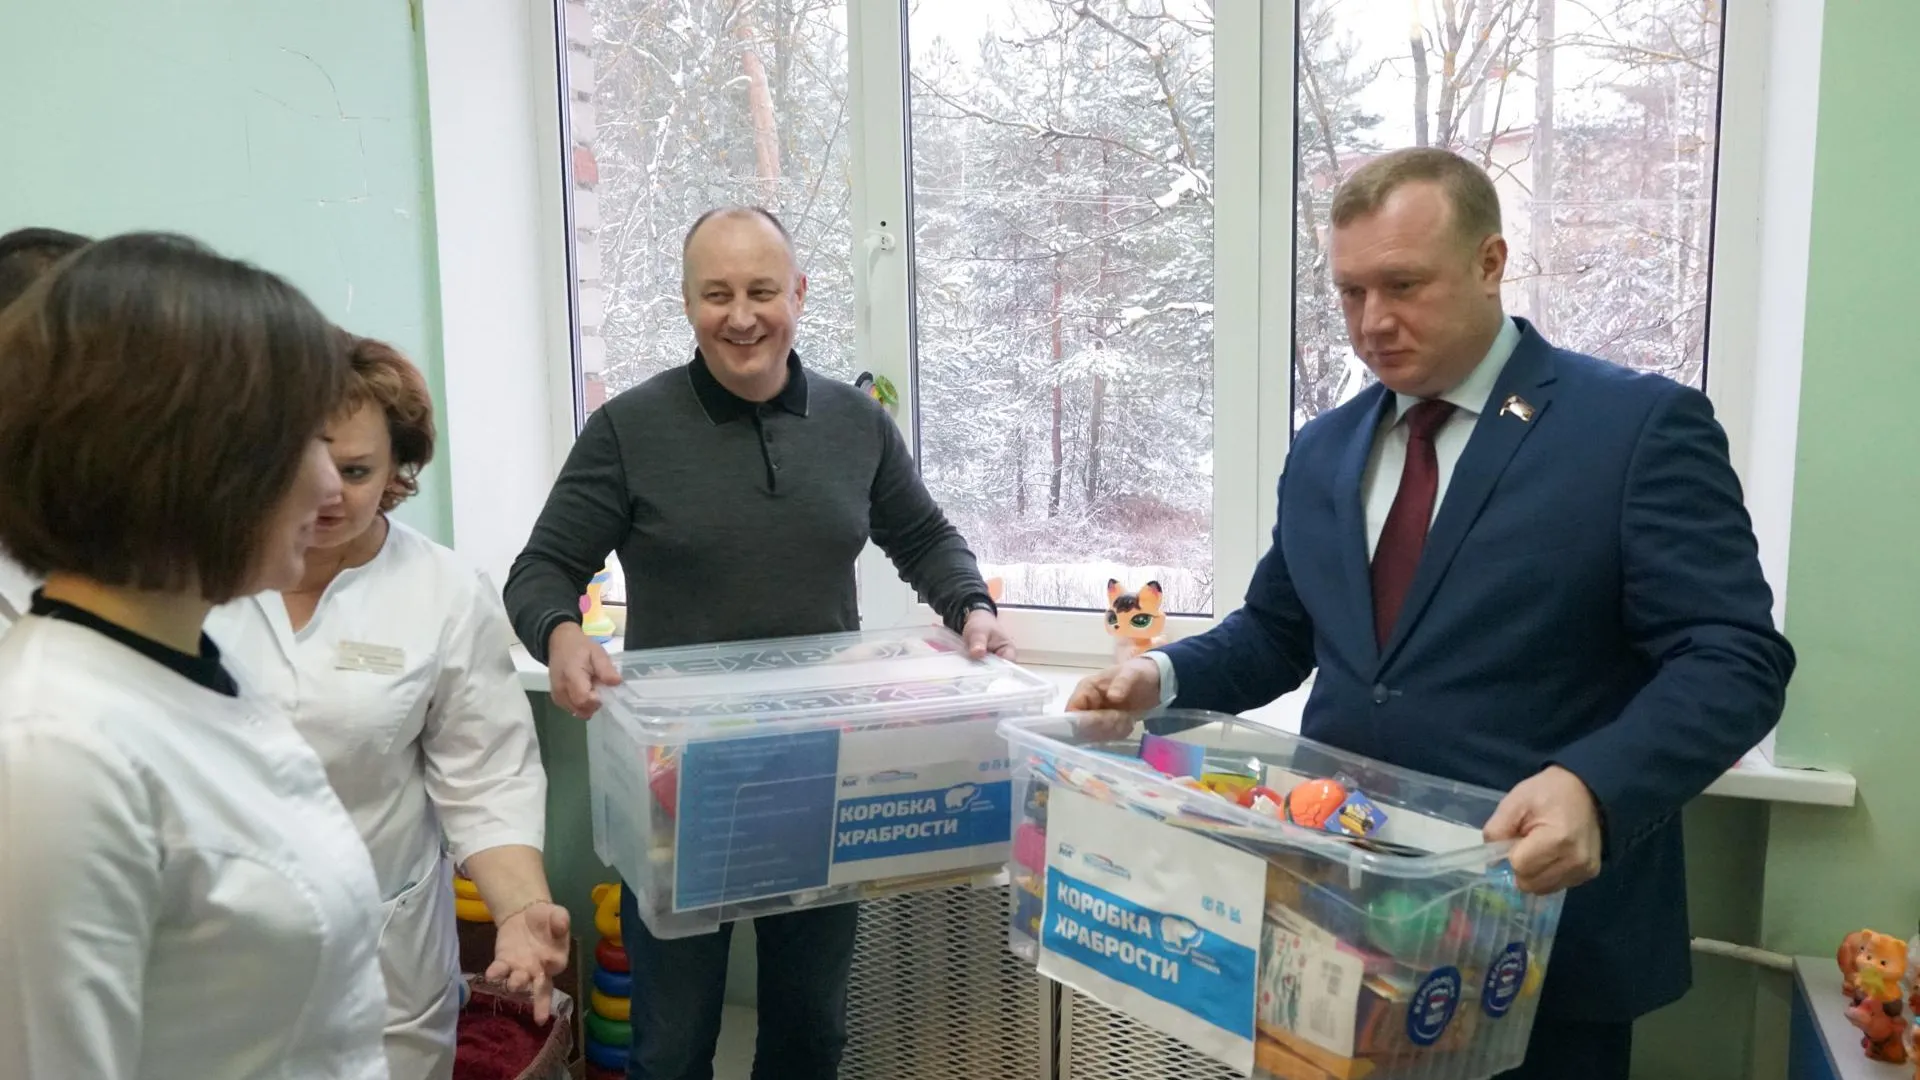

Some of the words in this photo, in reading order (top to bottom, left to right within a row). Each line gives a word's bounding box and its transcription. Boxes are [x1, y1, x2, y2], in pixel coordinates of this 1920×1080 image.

[839, 797, 937, 823] КОРОБКА
[836, 818, 958, 848] ХРАБРОСТИ
[1056, 880, 1153, 939] КОРОБКА
[1054, 912, 1180, 984] ХРАБРОСТИ
